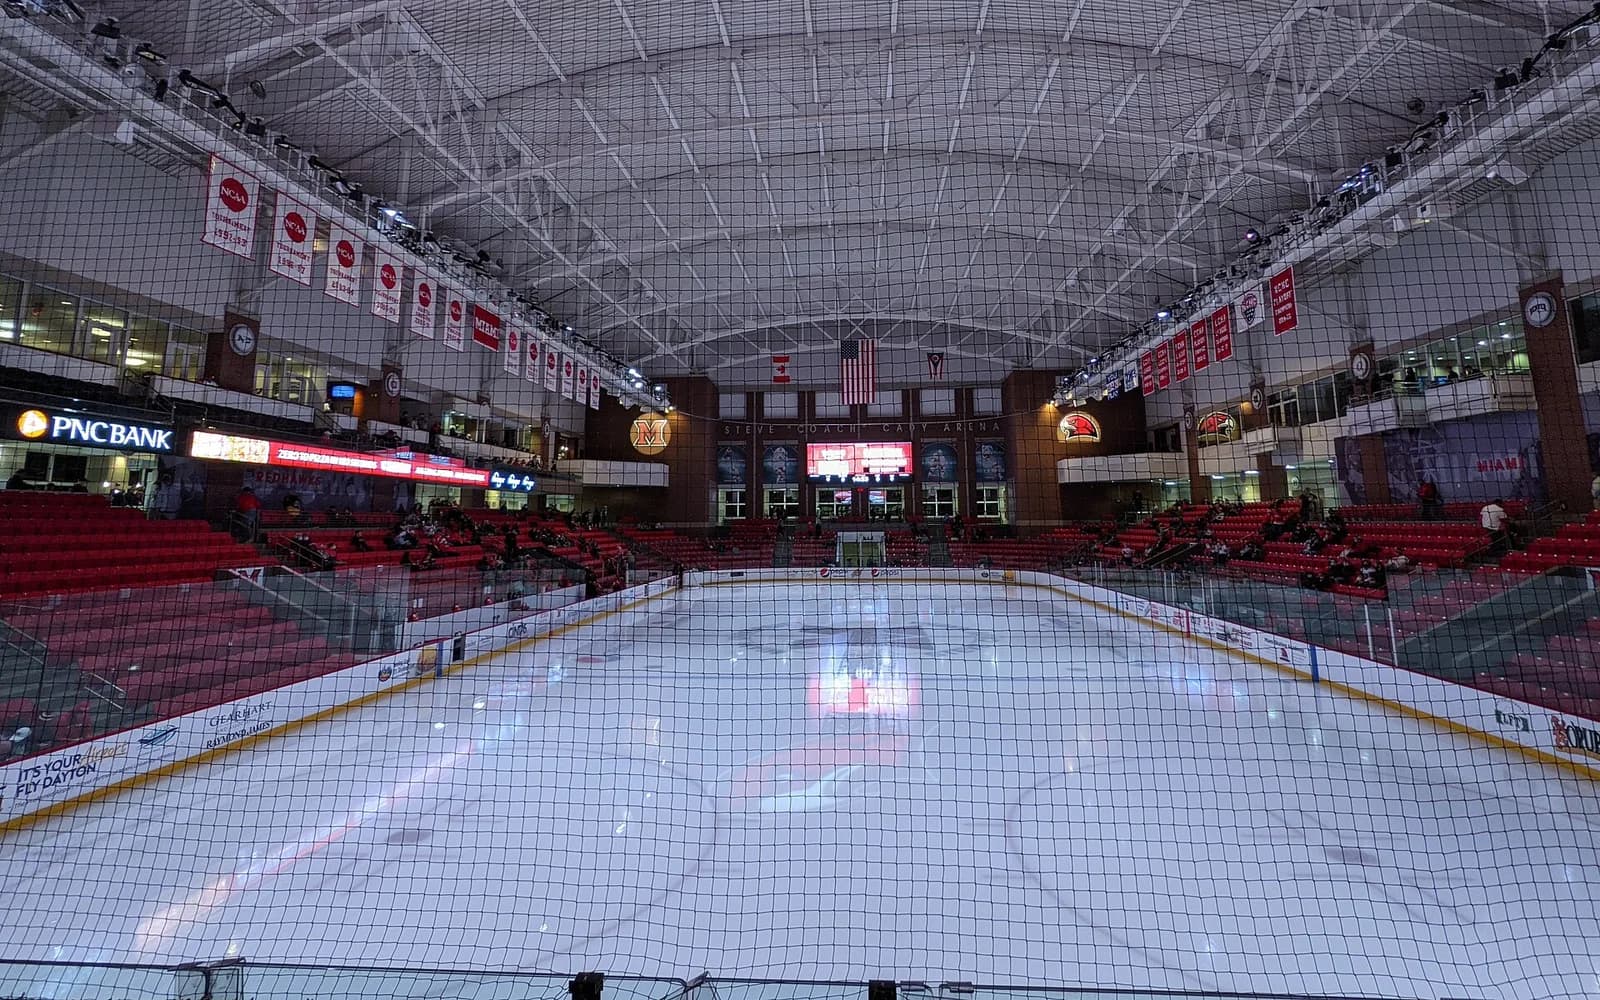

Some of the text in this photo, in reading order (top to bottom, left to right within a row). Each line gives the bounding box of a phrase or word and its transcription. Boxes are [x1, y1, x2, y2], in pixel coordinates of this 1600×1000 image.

[475, 316, 500, 338] MIAMI
[724, 424, 775, 434] STEVE
[882, 423, 928, 433] CADY
[943, 422, 1000, 432] ARENA
[1477, 455, 1525, 473] MIAMI
[209, 701, 272, 727] GEARHART
[44, 754, 82, 775] YOUR
[16, 779, 41, 798] FLY
[43, 763, 96, 789] DAYTON
